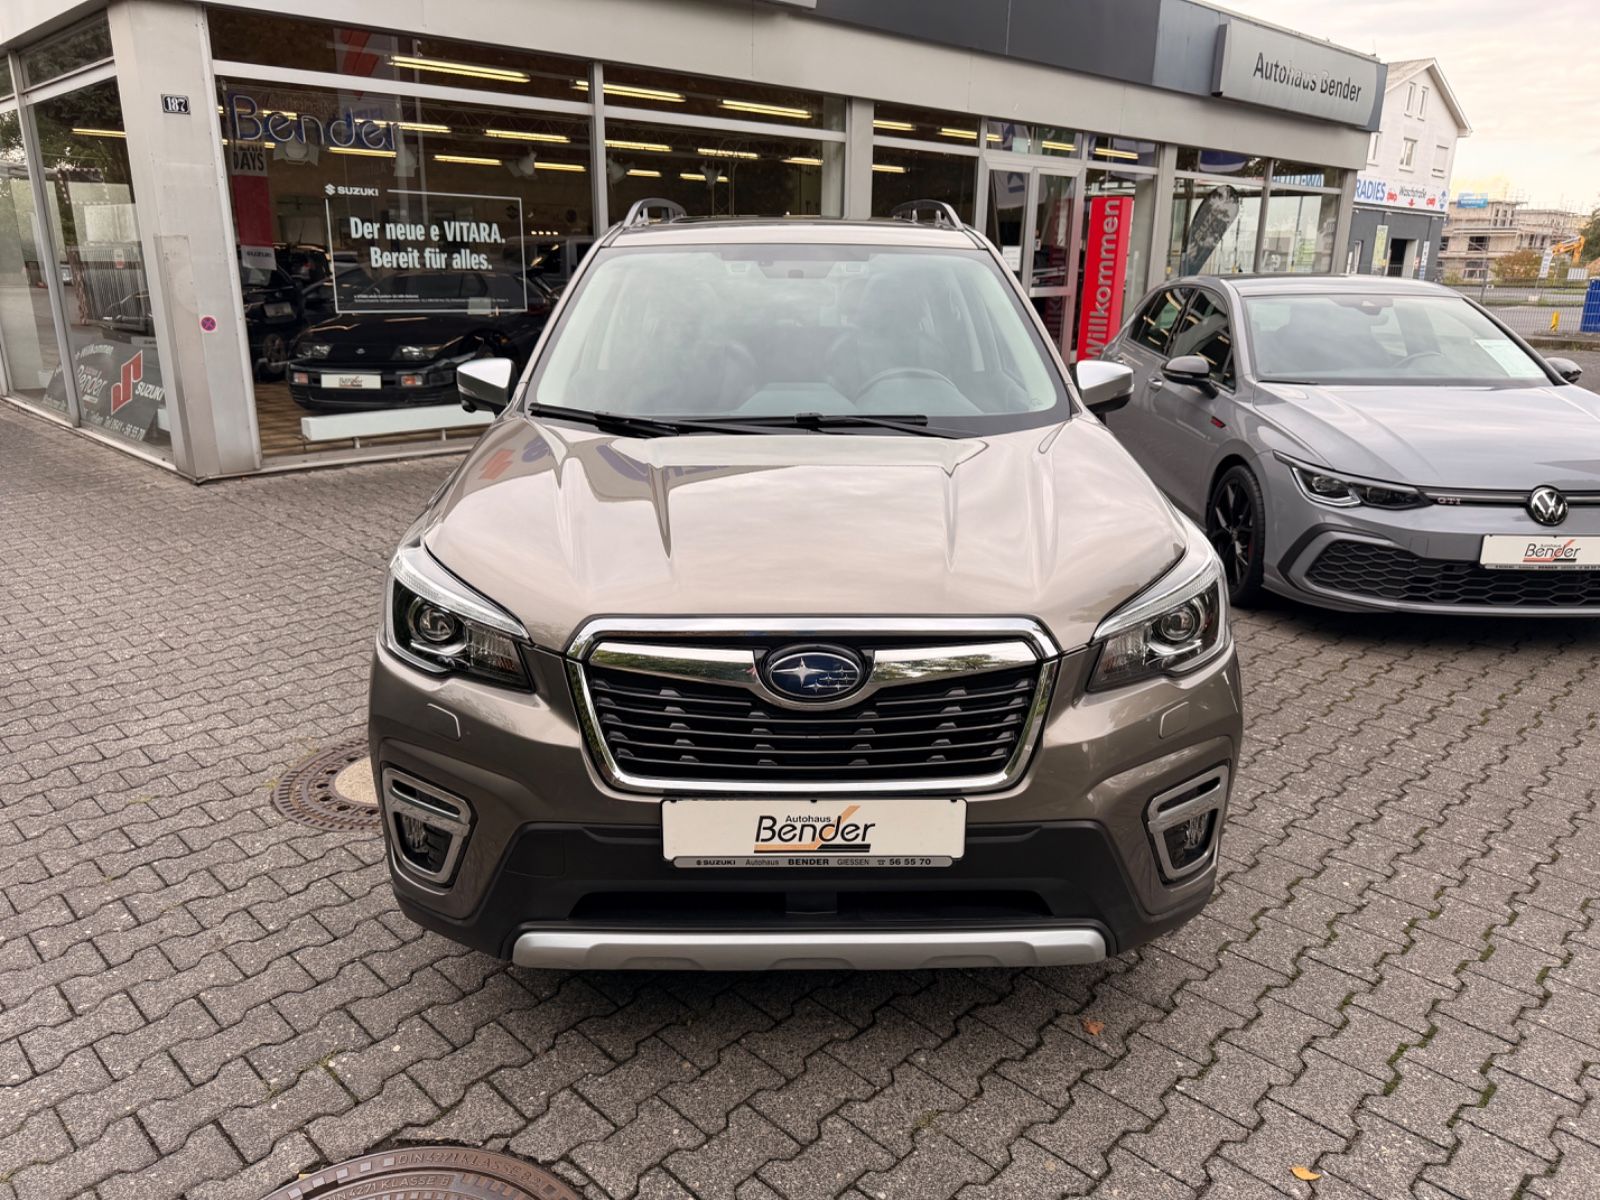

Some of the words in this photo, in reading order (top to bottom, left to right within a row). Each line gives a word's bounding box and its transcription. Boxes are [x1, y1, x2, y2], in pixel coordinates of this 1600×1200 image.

[1253, 52, 1317, 92] Autohaus
[1320, 70, 1362, 103] Bender
[164, 97, 186, 112] 187
[230, 94, 398, 150] Bender
[233, 151, 265, 172] DAYS
[337, 185, 379, 196] SUZUKI
[1356, 179, 1386, 201] RADIES
[350, 217, 380, 239] Der
[385, 222, 425, 241] neue
[430, 224, 440, 241] e
[443, 220, 506, 243] VITARA.
[370, 246, 421, 268] Bereit
[424, 248, 448, 269] für
[452, 248, 493, 270] alles.
[1084, 200, 1120, 361] Willkommen
[135, 381, 166, 401] SUZUKI
[1437, 497, 1461, 505] GTI
[1524, 542, 1581, 558] Bender
[755, 815, 876, 843] Bender
[785, 815, 832, 823] Autohaus
[703, 858, 736, 866] SUZUKI
[745, 858, 780, 867] Autohaus
[788, 858, 829, 866] BENDER
[837, 858, 870, 866] GIESSEN
[889, 858, 901, 866] 56
[904, 858, 916, 866] 55
[919, 858, 931, 866] 70
[398, 1152, 423, 1165] DIN
[381, 1175, 435, 1190] KLASSE
